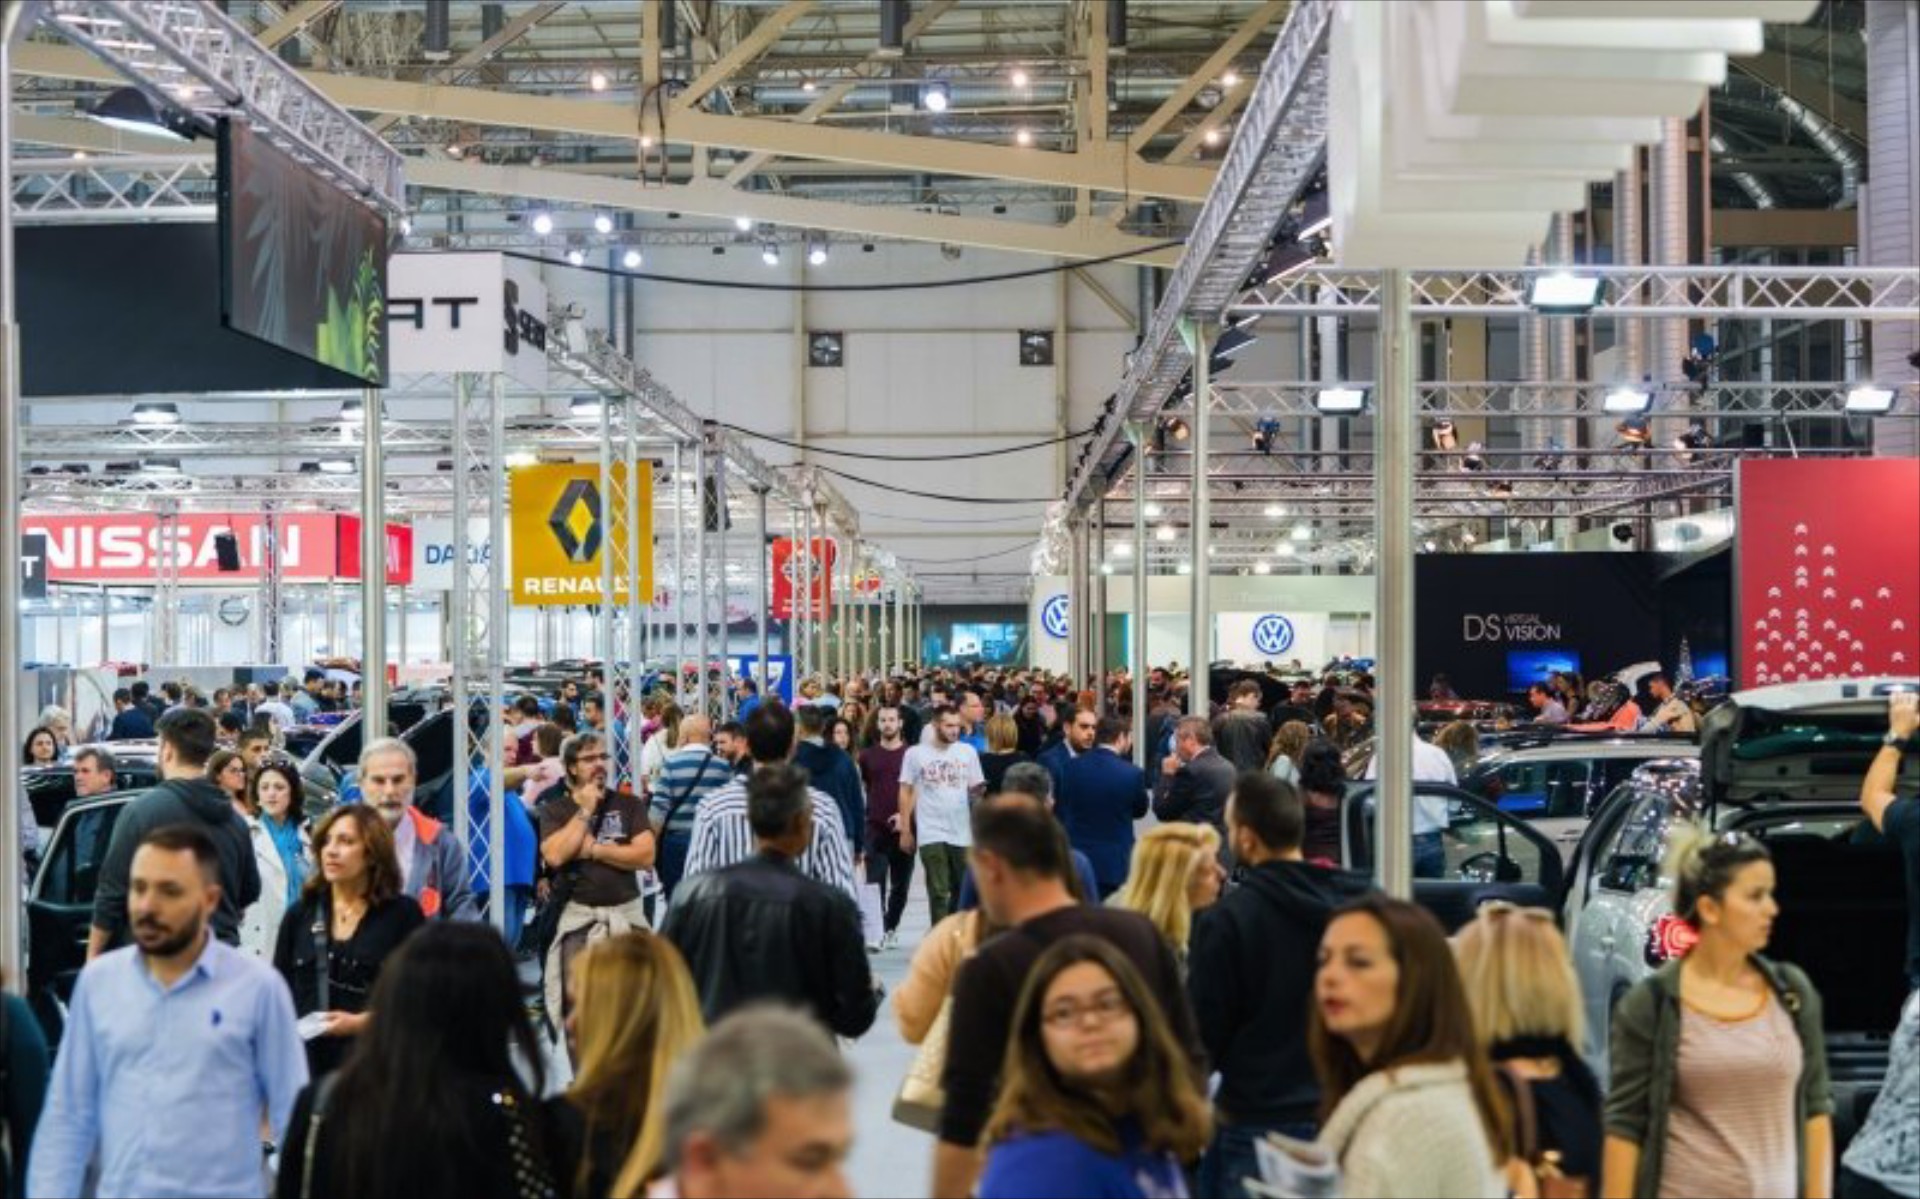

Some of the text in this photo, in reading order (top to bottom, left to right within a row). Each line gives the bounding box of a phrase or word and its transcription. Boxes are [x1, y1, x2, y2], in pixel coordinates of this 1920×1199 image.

[523, 576, 642, 595] RENAL
[1463, 613, 1501, 641] DS
[1503, 624, 1561, 641] VISION
